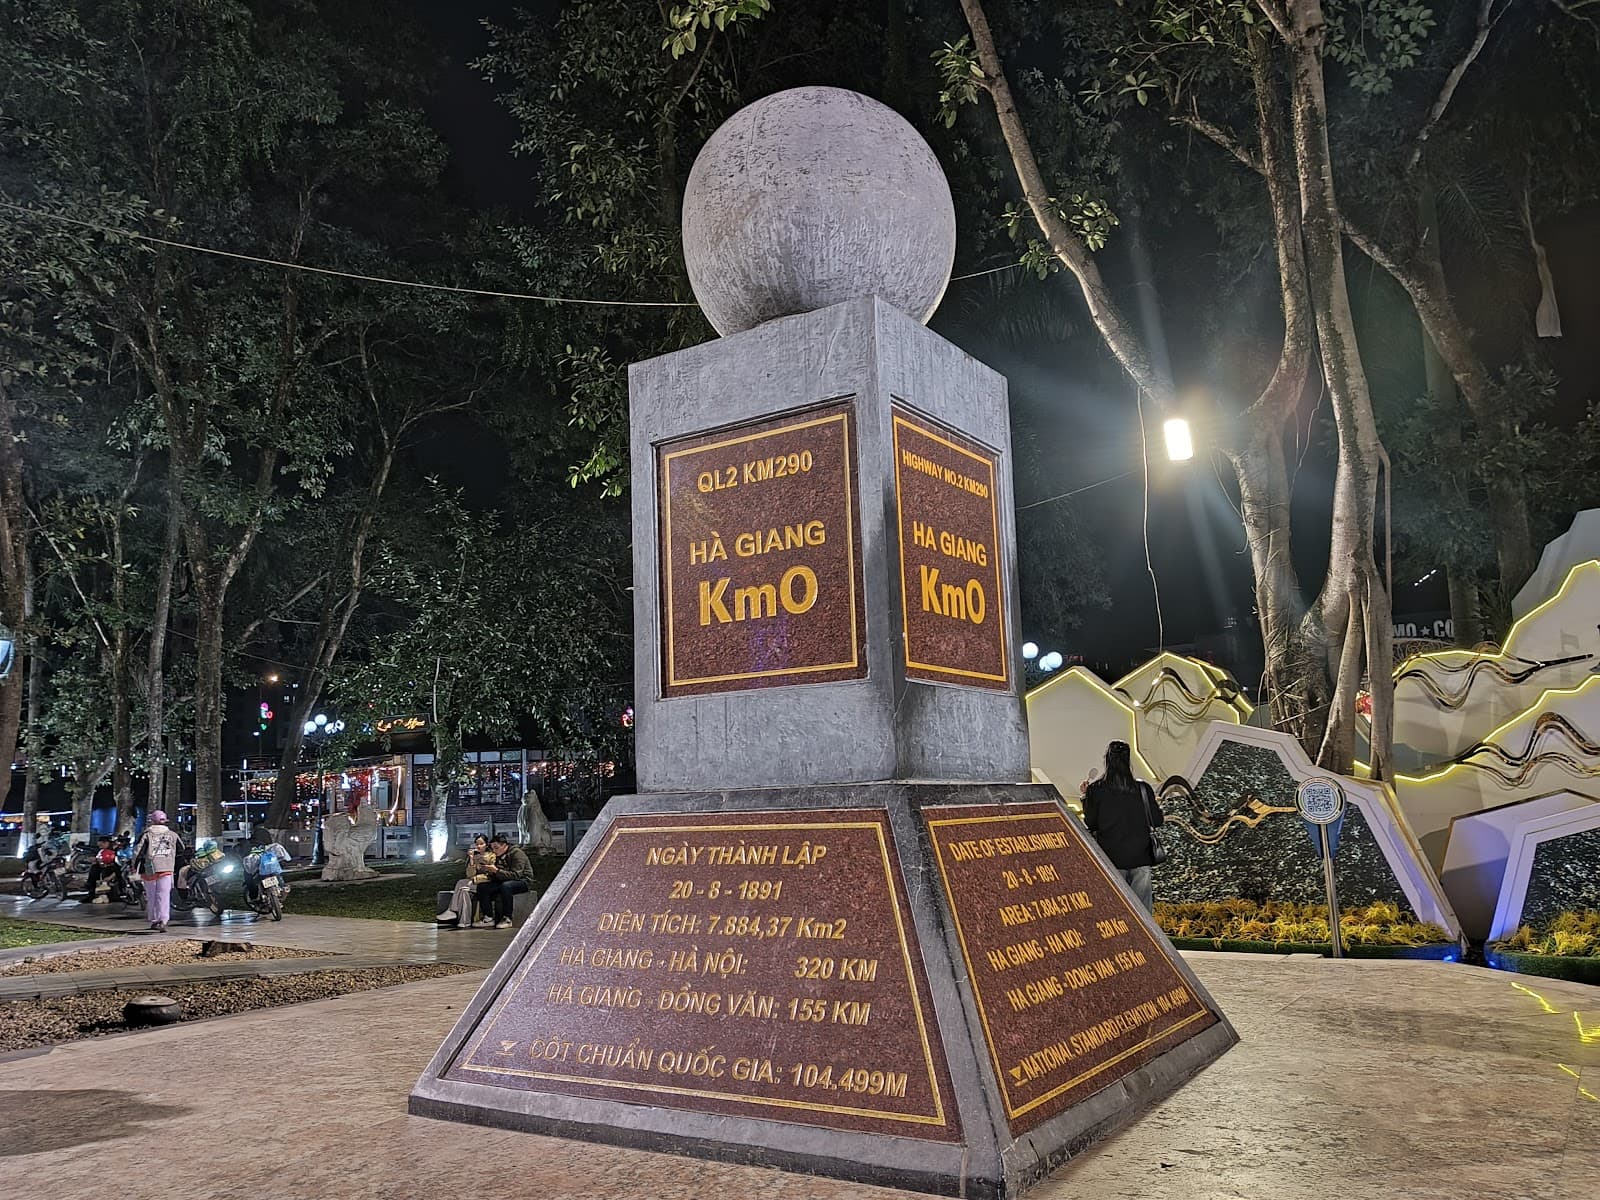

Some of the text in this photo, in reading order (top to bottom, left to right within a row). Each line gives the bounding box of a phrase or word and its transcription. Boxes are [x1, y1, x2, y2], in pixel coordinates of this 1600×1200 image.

[697, 449, 813, 493] QL2 KM290
[902, 449, 943, 479] HIGHWAY
[964, 476, 988, 498] KM290
[689, 519, 826, 566] HÀ GIANG
[913, 521, 987, 567] HA GIANG
[645, 840, 827, 870] NGÀY THÀNH LẬP
[948, 831, 1070, 862] DATE OF ESTABLISHMENT
[669, 880, 694, 900] 20
[708, 880, 721, 900] 8
[738, 880, 783, 900] 1891
[1035, 863, 1060, 883] 1891
[598, 909, 847, 941] DIỆN TÍCH: 7.884,37 Km2
[998, 890, 1094, 927] AREA: 7.884,37 KM2
[560, 941, 587, 966] HÀ
[591, 948, 654, 969] GIANG
[668, 944, 698, 973] HÀ
[703, 946, 748, 979] NỘI:
[794, 956, 834, 979] 320
[839, 958, 878, 982] KM
[986, 949, 1011, 972] HA
[1006, 939, 1045, 966] GIANG
[1045, 933, 1064, 955] HA
[1062, 928, 1087, 950] NOI:
[1095, 920, 1116, 940] 320
[1112, 917, 1130, 936] Km
[547, 979, 575, 1004] HÀ
[580, 985, 643, 1009] GIANG
[659, 982, 721, 1015] ĐỒNG
[728, 989, 780, 1019] VĂN:
[788, 997, 827, 1023] 155
[831, 1000, 871, 1026] KM
[1006, 988, 1031, 1012] HA
[1025, 975, 1064, 1005] GIANG
[1064, 963, 1098, 991] DONG
[1094, 957, 1119, 980] VAN:
[1114, 951, 1134, 972] 155
[1129, 949, 1148, 967] Km
[576, 1037, 653, 1071] CHUẨN
[657, 1045, 727, 1078] QUỐC
[731, 1056, 783, 1085] GIA:
[791, 1062, 908, 1098] 104.499M
[1020, 1040, 1076, 1081] NATIONAL
[1069, 1018, 1121, 1054] STANDARD
